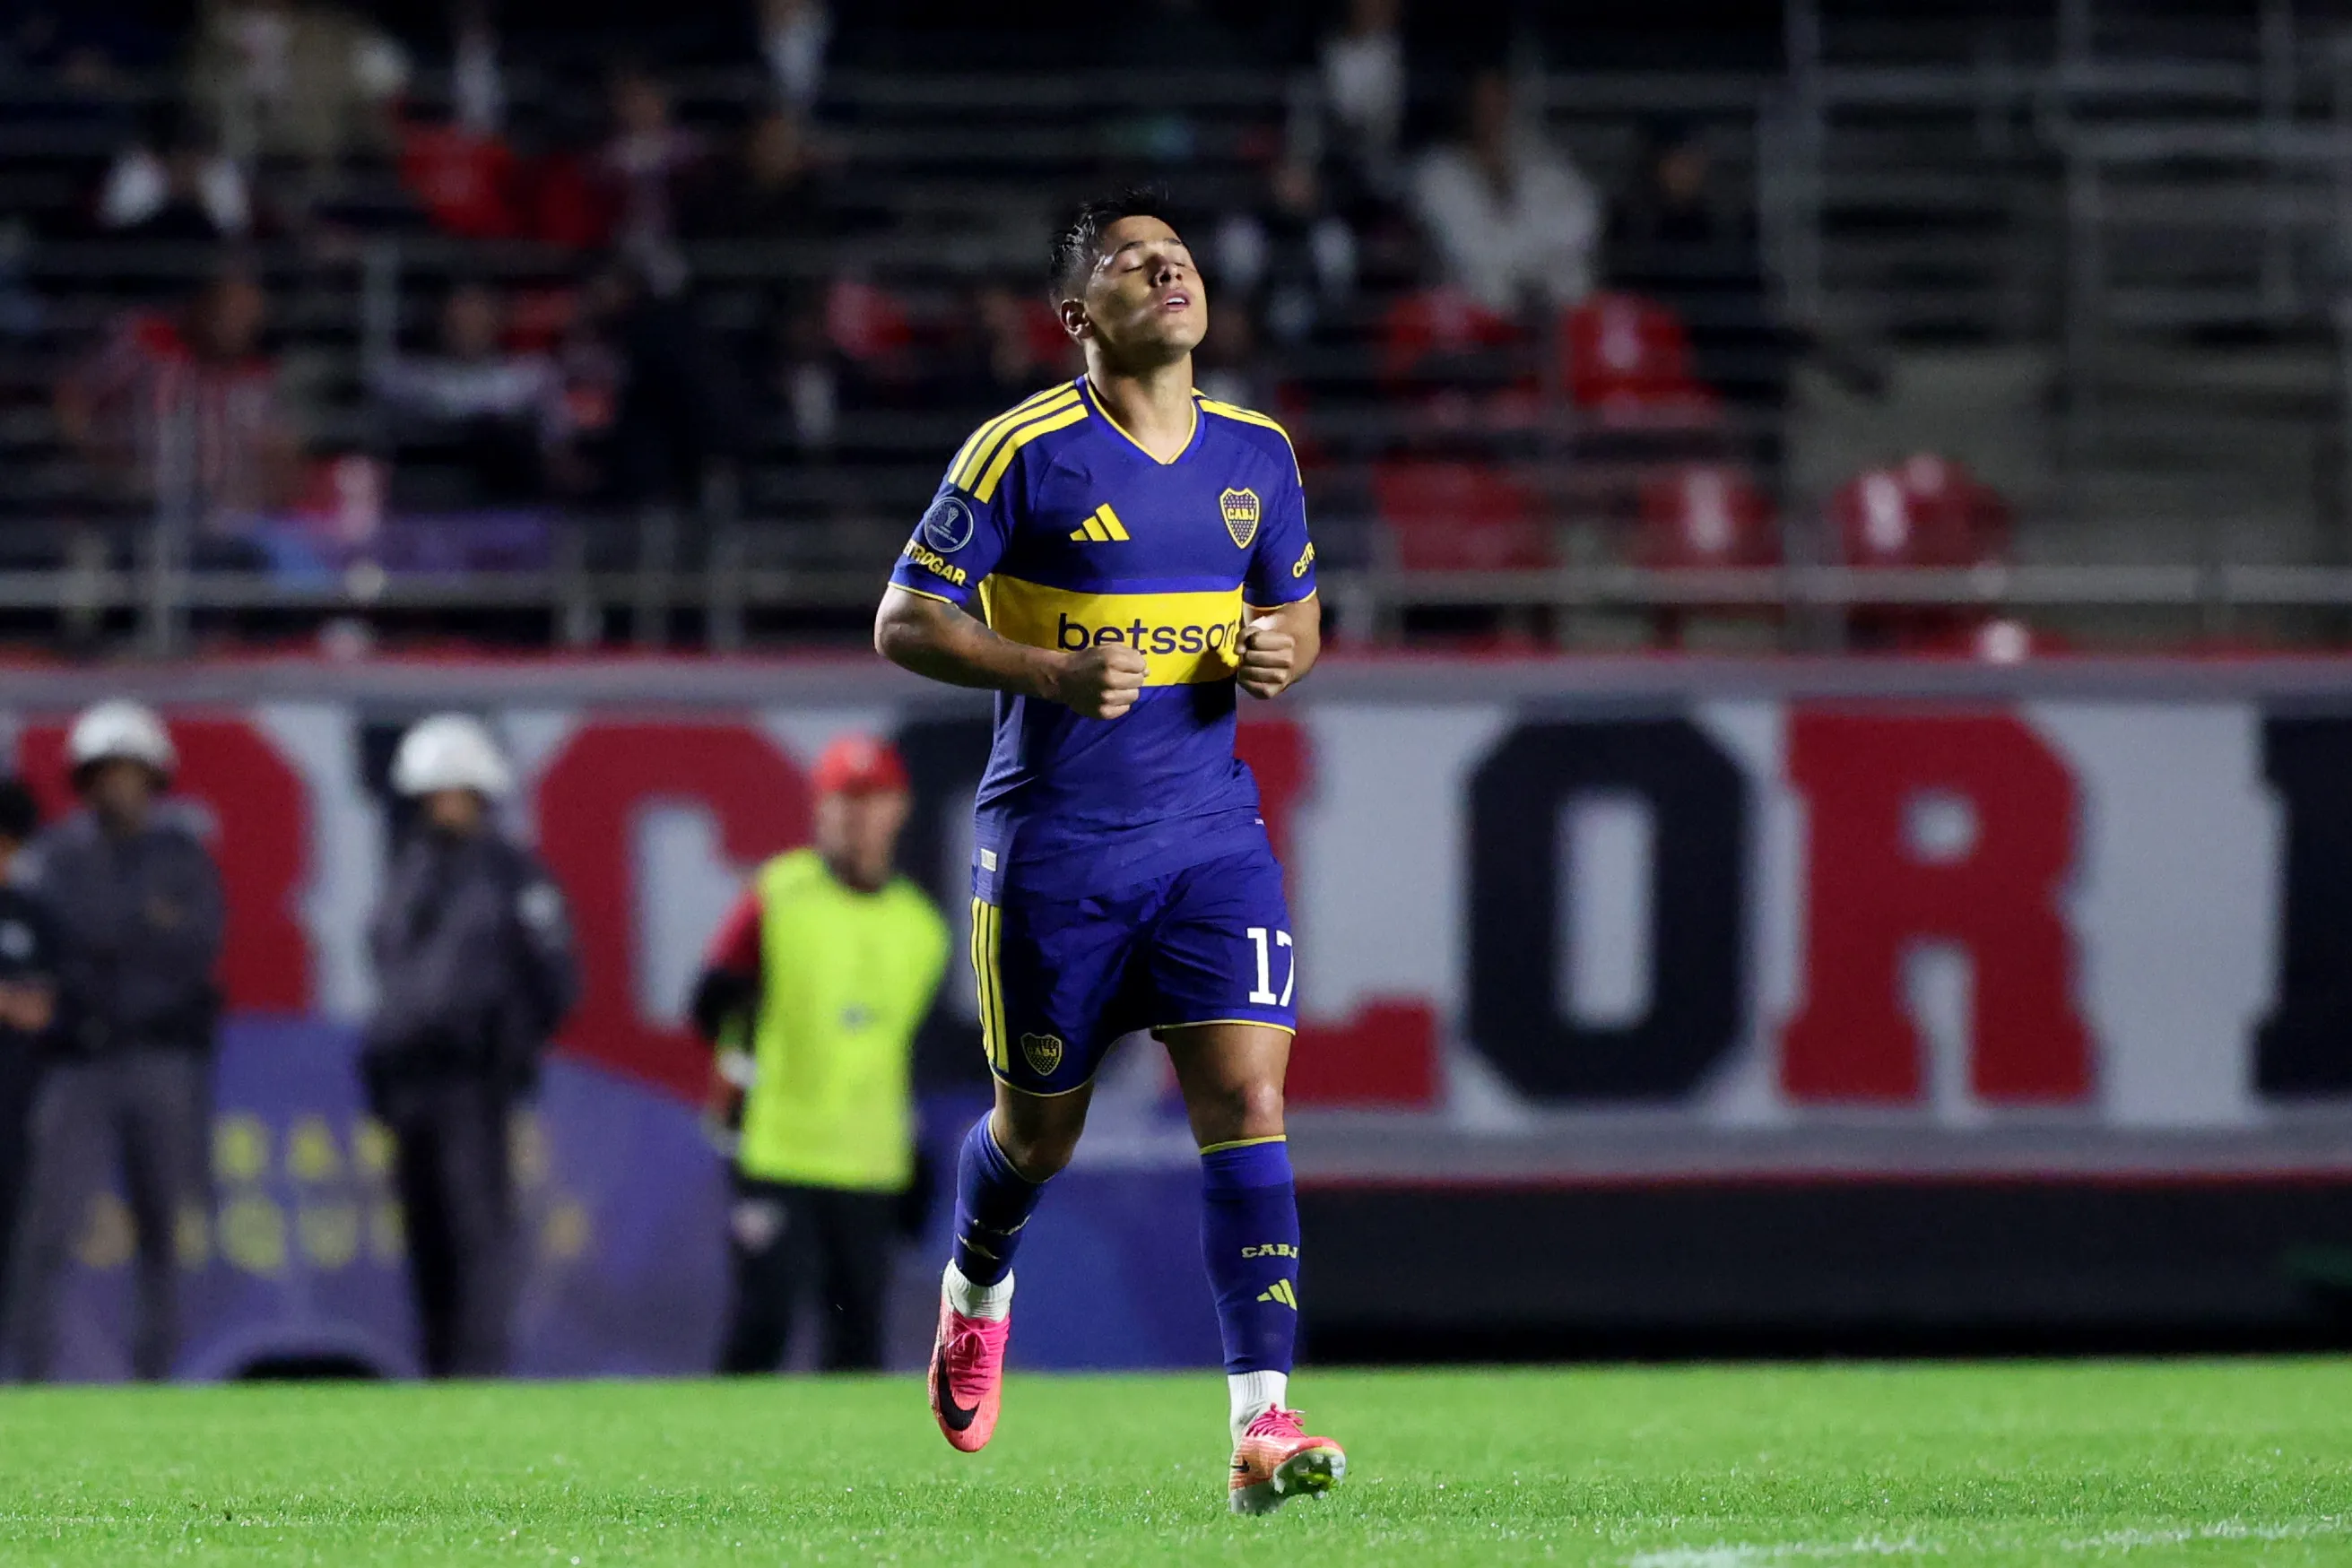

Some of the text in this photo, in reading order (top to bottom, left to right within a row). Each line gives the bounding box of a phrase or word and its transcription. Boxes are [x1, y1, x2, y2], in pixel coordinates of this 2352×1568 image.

[1227, 507, 1254, 520] CABJ
[1246, 927, 1294, 1007] 17
[1241, 1243, 1298, 1259] CABJ
